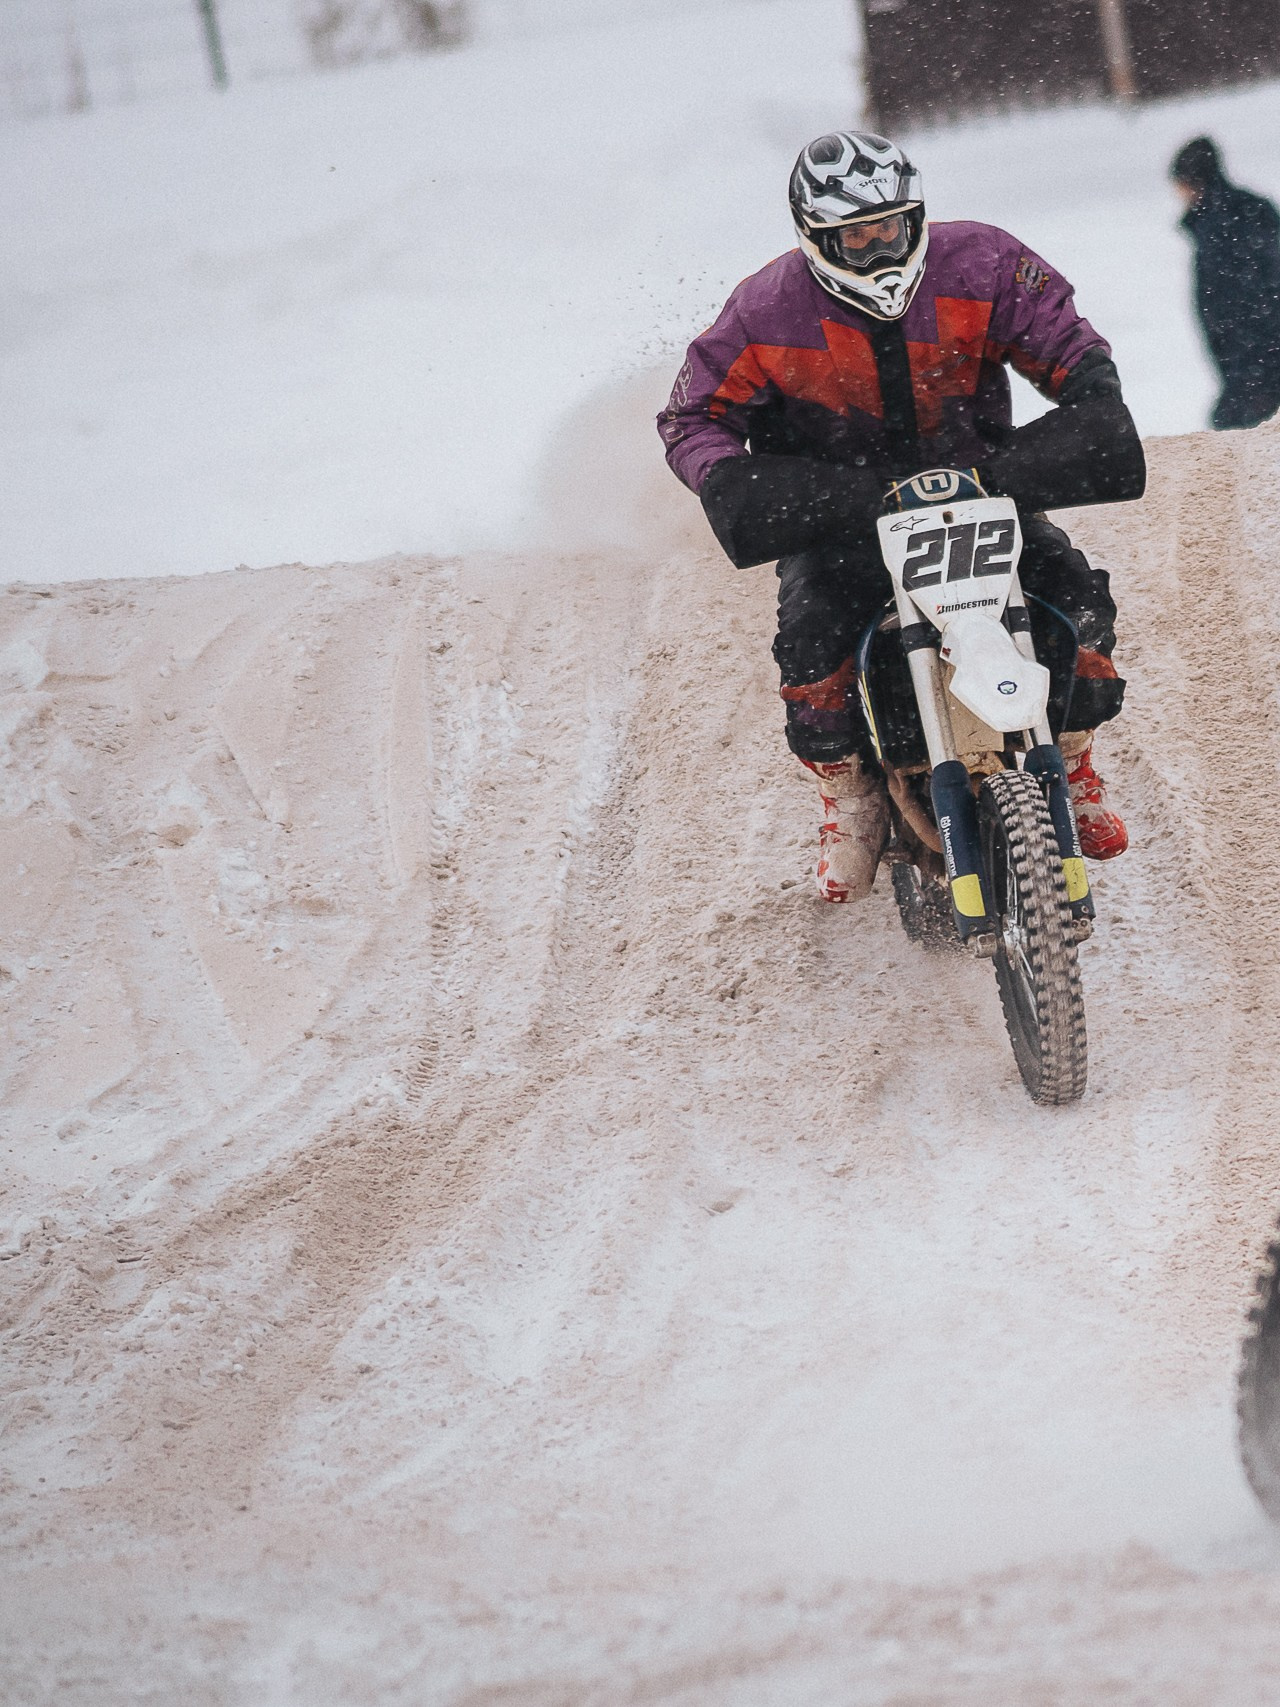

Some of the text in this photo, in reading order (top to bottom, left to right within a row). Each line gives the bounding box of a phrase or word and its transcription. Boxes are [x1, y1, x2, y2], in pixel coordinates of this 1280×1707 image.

[858, 178, 888, 187] SHOEI
[902, 519, 1015, 593] 212
[936, 598, 999, 615] BRIDGESTONE
[942, 827, 958, 877] Husqvarna
